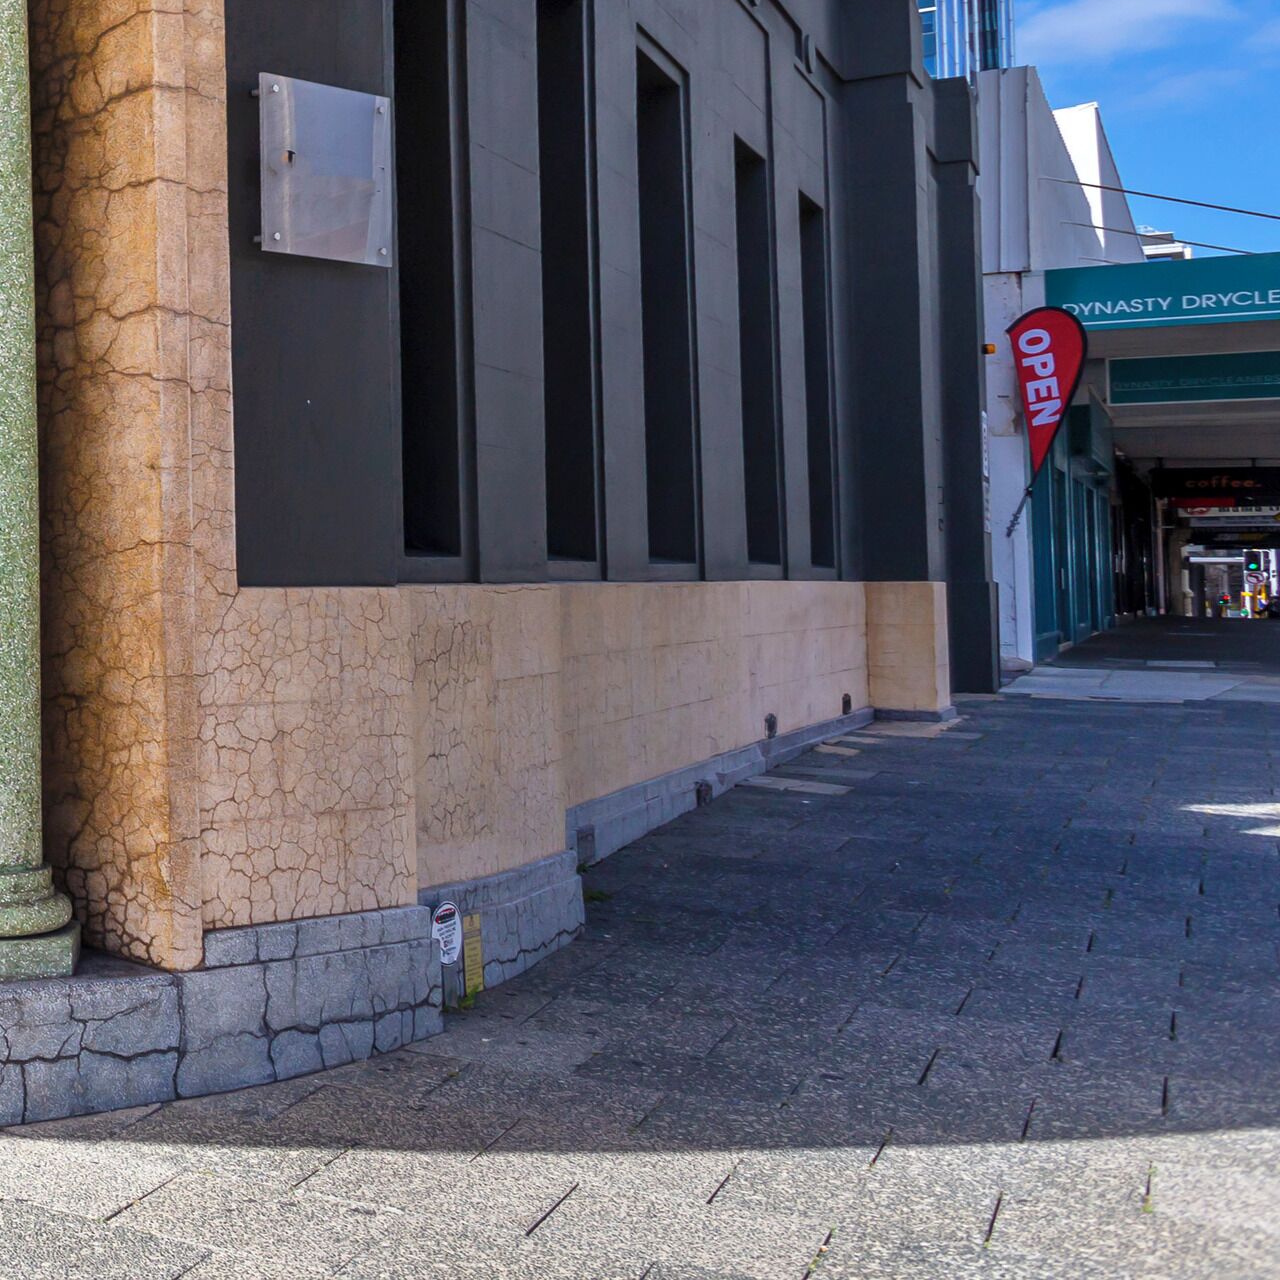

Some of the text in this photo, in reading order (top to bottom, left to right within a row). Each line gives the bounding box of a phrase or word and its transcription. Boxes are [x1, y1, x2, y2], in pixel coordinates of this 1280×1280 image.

[1062, 289, 1280, 315] DYNASTY DRYCLE
[1018, 328, 1063, 427] OPEN
